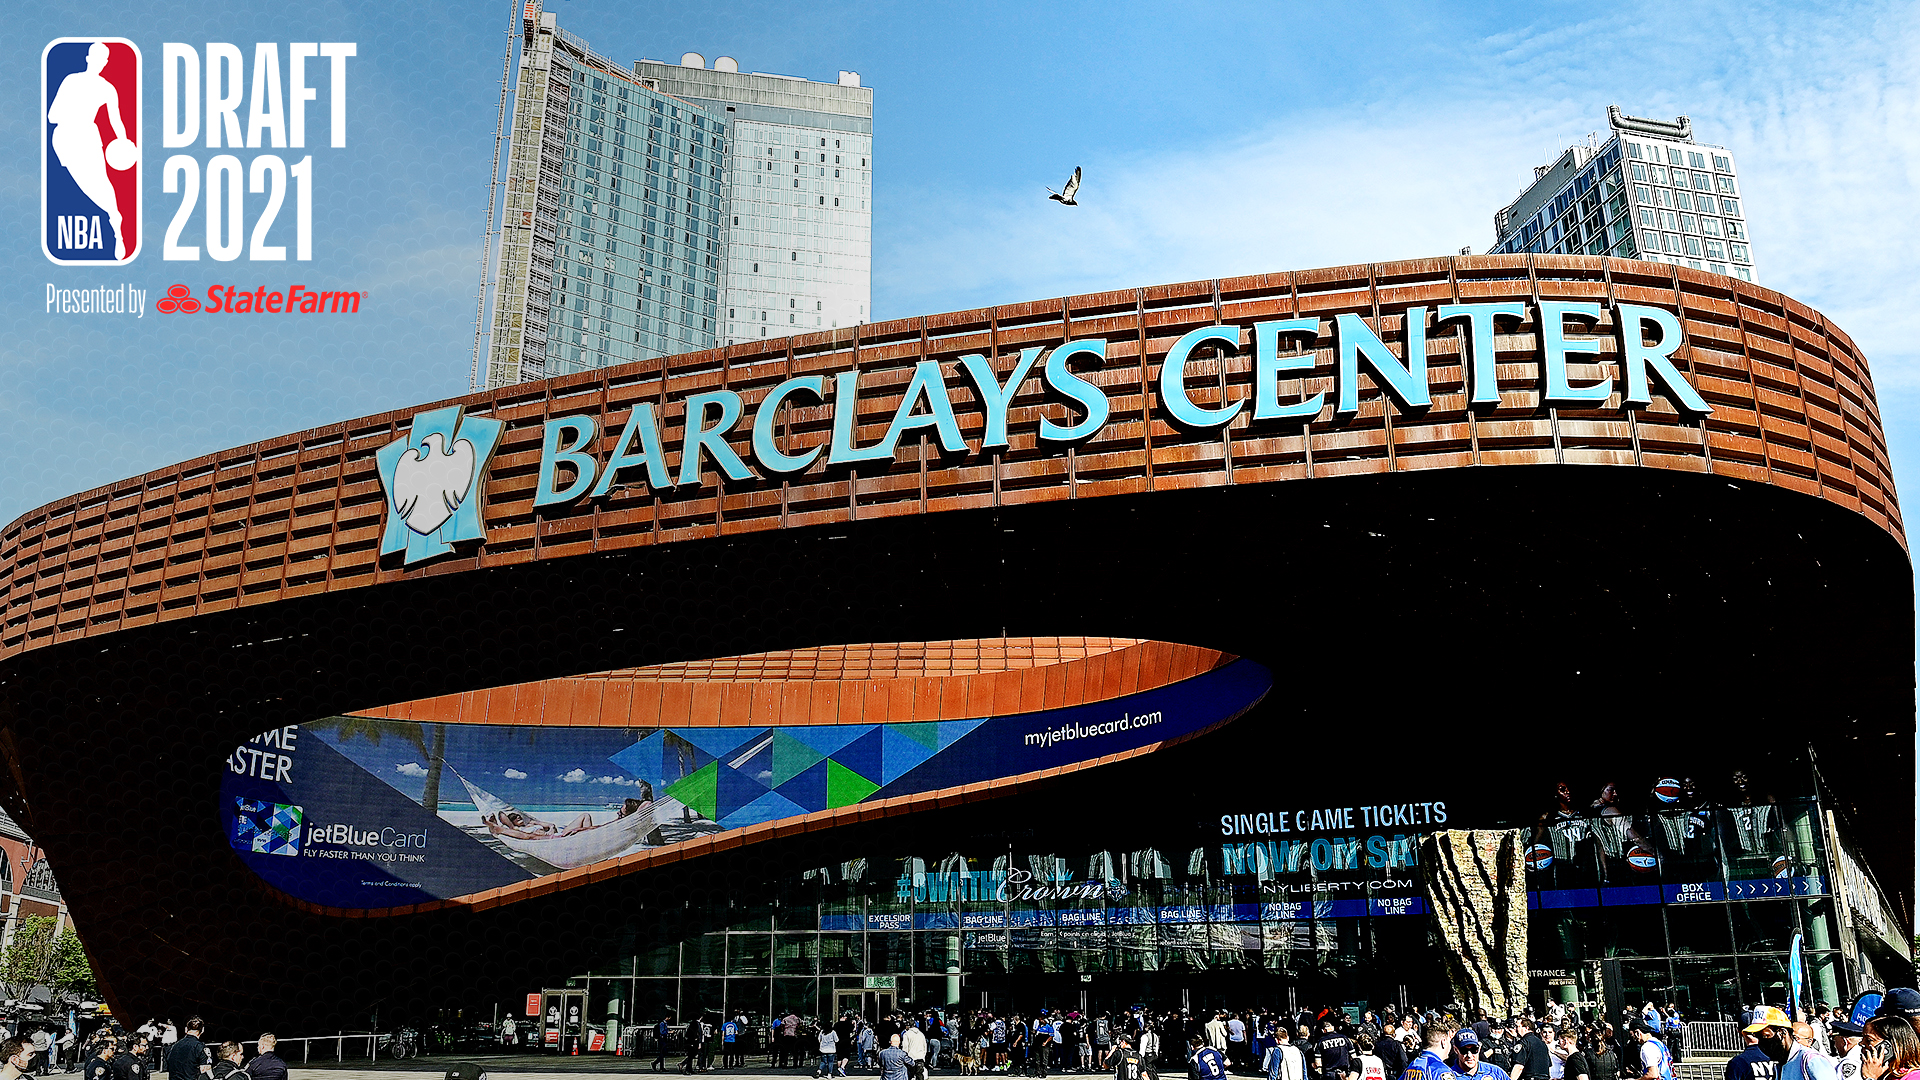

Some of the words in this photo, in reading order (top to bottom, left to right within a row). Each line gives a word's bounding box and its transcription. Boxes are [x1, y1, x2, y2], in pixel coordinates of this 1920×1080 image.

[532, 337, 1109, 507] BARCLAYS
[1160, 301, 1713, 429] CENTER
[1024, 711, 1162, 748] myjetbluecard.com
[1220, 811, 1290, 836] SINGLE
[1296, 807, 1355, 832] GAME
[1360, 801, 1447, 828] TICKETS
[303, 848, 318, 858] FLY
[318, 849, 350, 860] FASTER
[350, 851, 375, 861] THAN
[376, 853, 397, 862] YOU
[398, 853, 426, 863] THINK
[1221, 839, 1302, 876] NOW
[1310, 836, 1359, 871] ON
[1366, 833, 1421, 870] SA
[1681, 883, 1704, 892] BOX
[1676, 891, 1712, 902] OFFICE
[1268, 903, 1282, 911] NO
[1283, 902, 1302, 911] BAG
[1377, 899, 1391, 907] NO
[1393, 898, 1412, 906] BAG
[1160, 910, 1179, 919] BAG
[1181, 909, 1201, 918] LINE
[1276, 910, 1296, 919] LINE
[1385, 906, 1406, 915] LINE
[868, 914, 911, 923] EXCELSIOR
[965, 916, 985, 924] BAG
[1061, 913, 1079, 922] BAG
[1081, 912, 1101, 921] LINE
[879, 921, 900, 929] PASS
[977, 933, 1007, 944] jetBlue
[1322, 1037, 1346, 1050] NYPD
[1127, 1063, 1138, 1079] 13
[1208, 1059, 1220, 1077] 6
